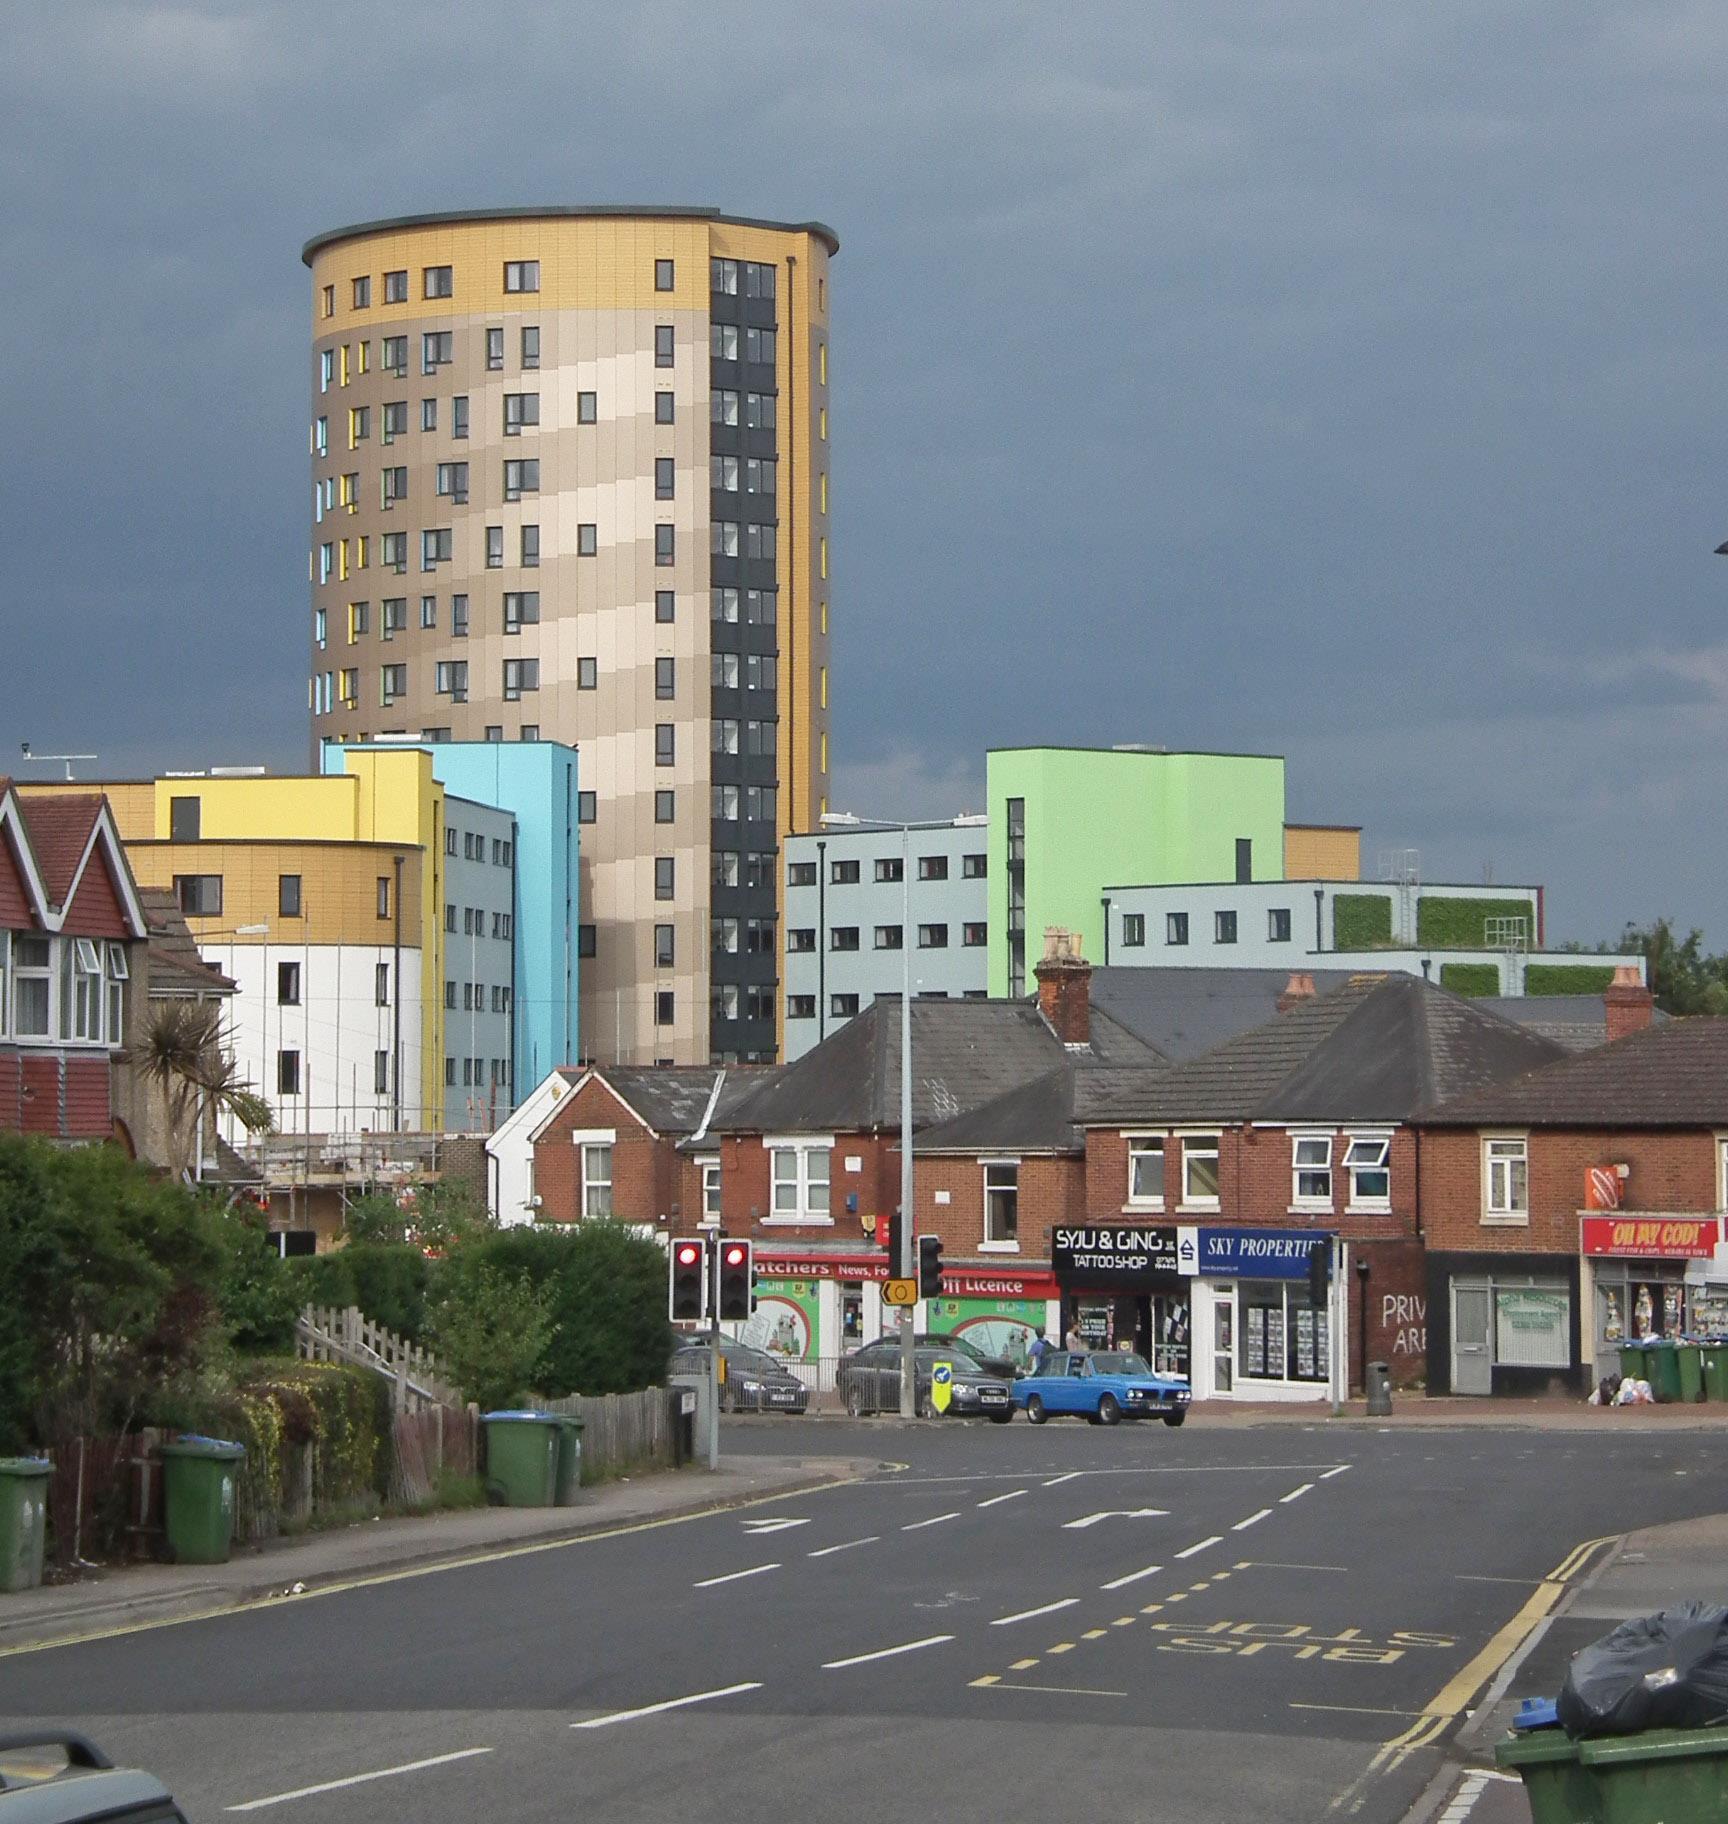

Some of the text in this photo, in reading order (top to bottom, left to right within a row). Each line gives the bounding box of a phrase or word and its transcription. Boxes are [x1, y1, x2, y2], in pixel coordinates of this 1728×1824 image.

[1056, 1230, 1096, 1249] SYJU
[1098, 1231, 1113, 1250] &
[1116, 1231, 1163, 1251] GING
[1208, 1238, 1324, 1258] SKY PROPERTI
[838, 1264, 871, 1277] News,
[874, 1266, 890, 1276] Fo
[1073, 1254, 1115, 1269] TATTOO
[1115, 1255, 1148, 1270] SHOP
[966, 1279, 1023, 1293] Licence
[1151, 1621, 1455, 1648] STOP
[1156, 1638, 1406, 1664] BUS
